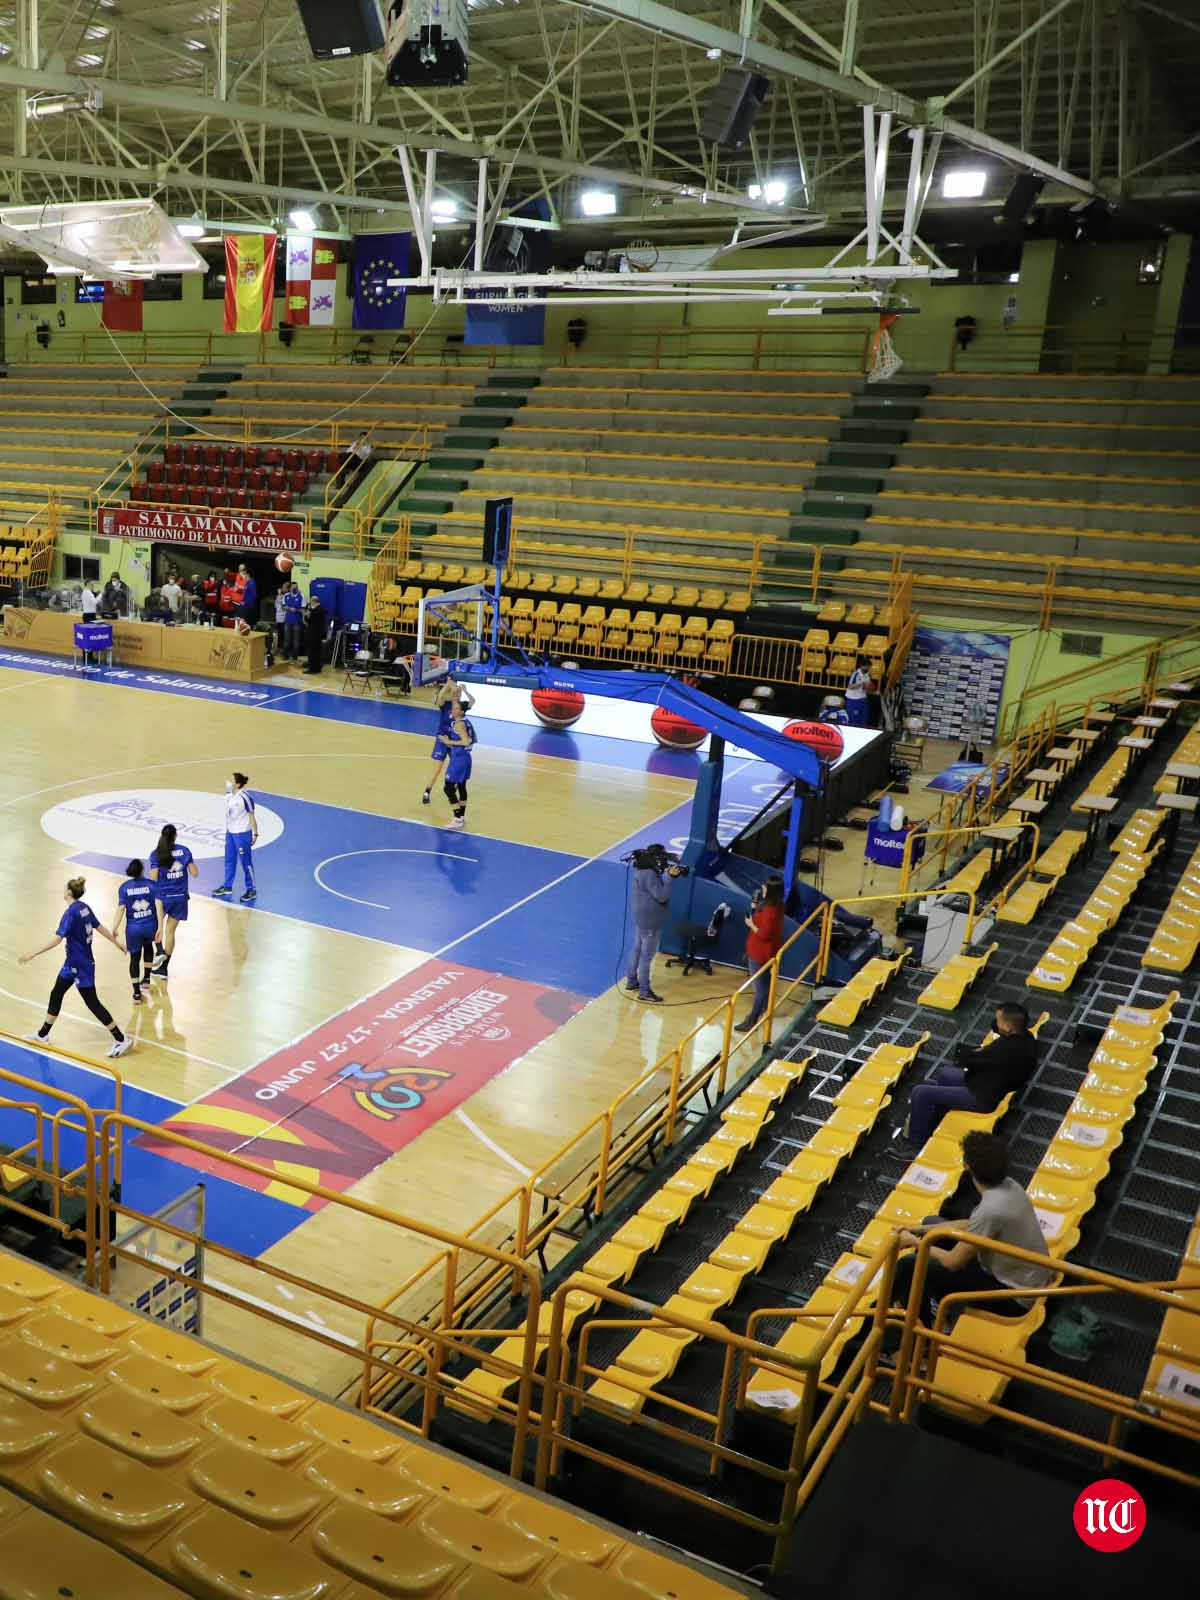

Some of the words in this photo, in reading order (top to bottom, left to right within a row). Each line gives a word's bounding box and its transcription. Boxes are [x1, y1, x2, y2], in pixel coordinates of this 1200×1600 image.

[118, 524, 186, 541] PATRIMONIO
[188, 531, 205, 543] DE
[207, 532, 223, 545] LA
[224, 533, 297, 551] HUMANIDAD
[138, 511, 278, 536] SALAMANCA
[103, 670, 135, 679] de
[136, 674, 271, 700] Salamanca
[791, 725, 834, 740] molten
[873, 837, 905, 849] molte
[375, 971, 465, 1019] VALENCIA
[398, 989, 509, 1058] EUROBASKET
[320, 1025, 373, 1062] 17-27
[255, 1061, 318, 1100] JUNIO
